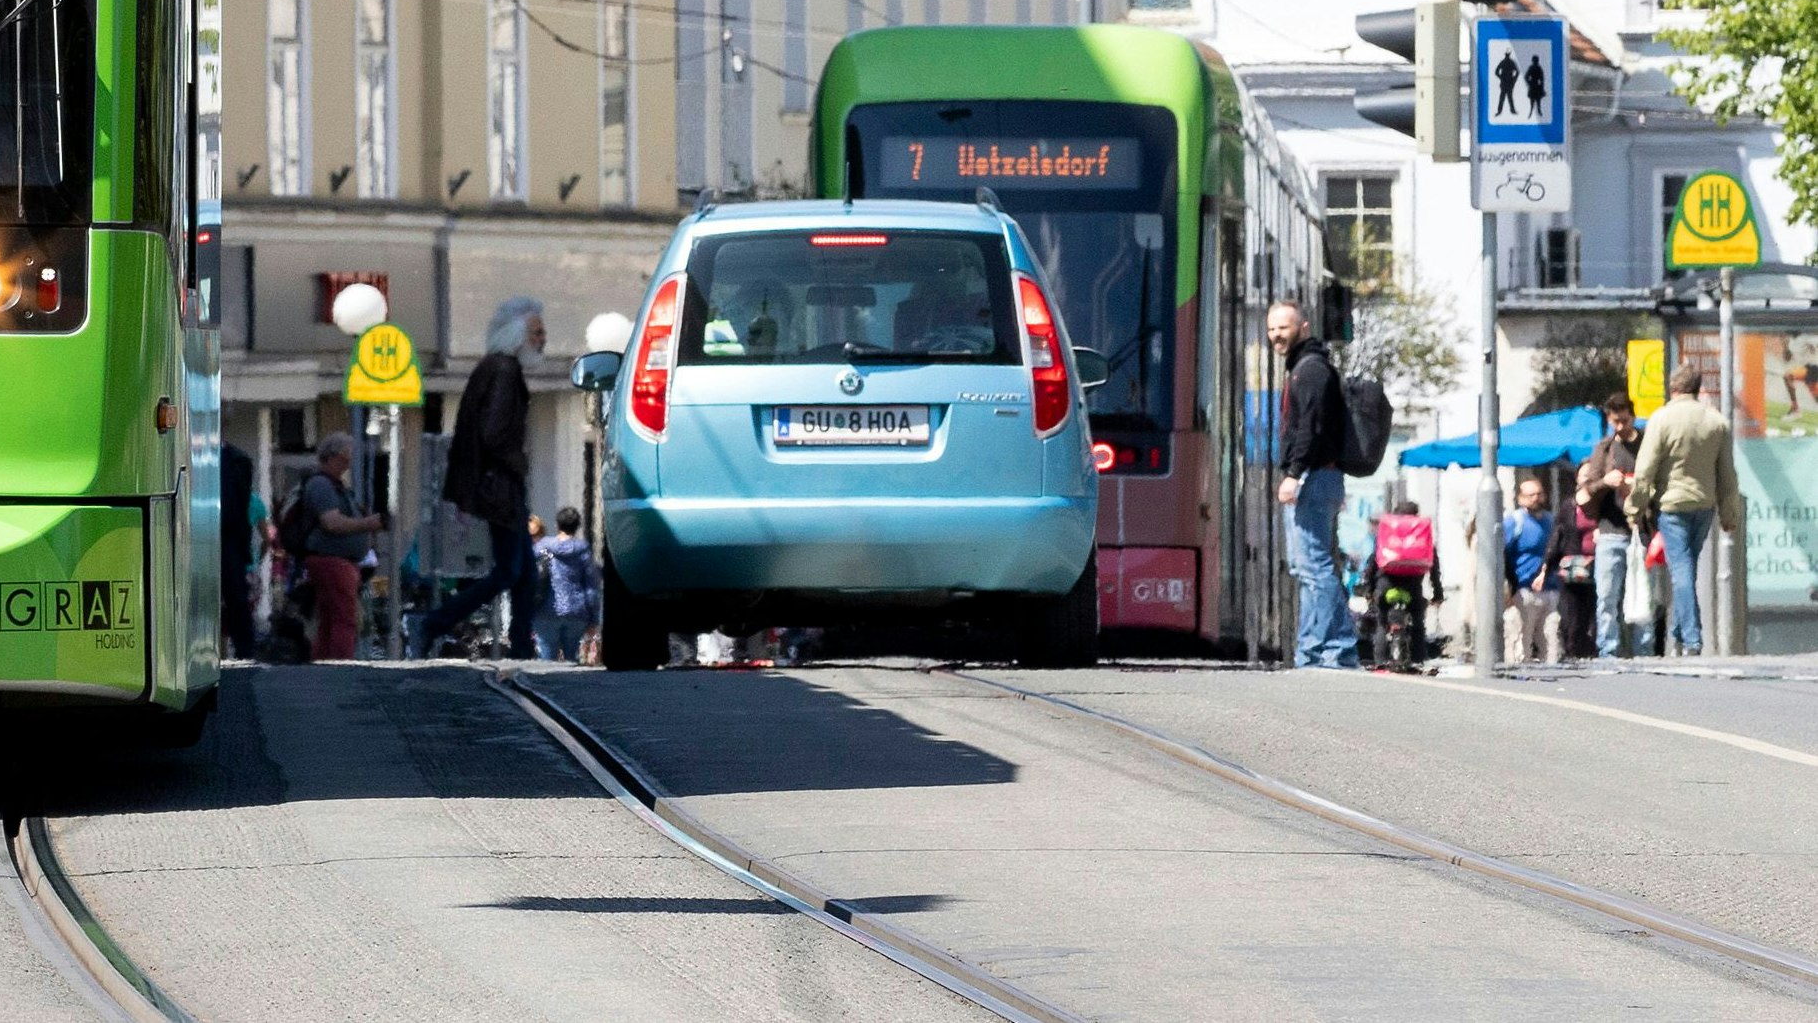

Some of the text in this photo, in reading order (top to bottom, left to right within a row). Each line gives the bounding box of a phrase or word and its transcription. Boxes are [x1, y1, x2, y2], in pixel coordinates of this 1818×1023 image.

[908, 142, 924, 181] 7
[802, 411, 831, 433] GU
[2, 582, 133, 629] GRAZ
[95, 634, 135, 649] HOLDING
